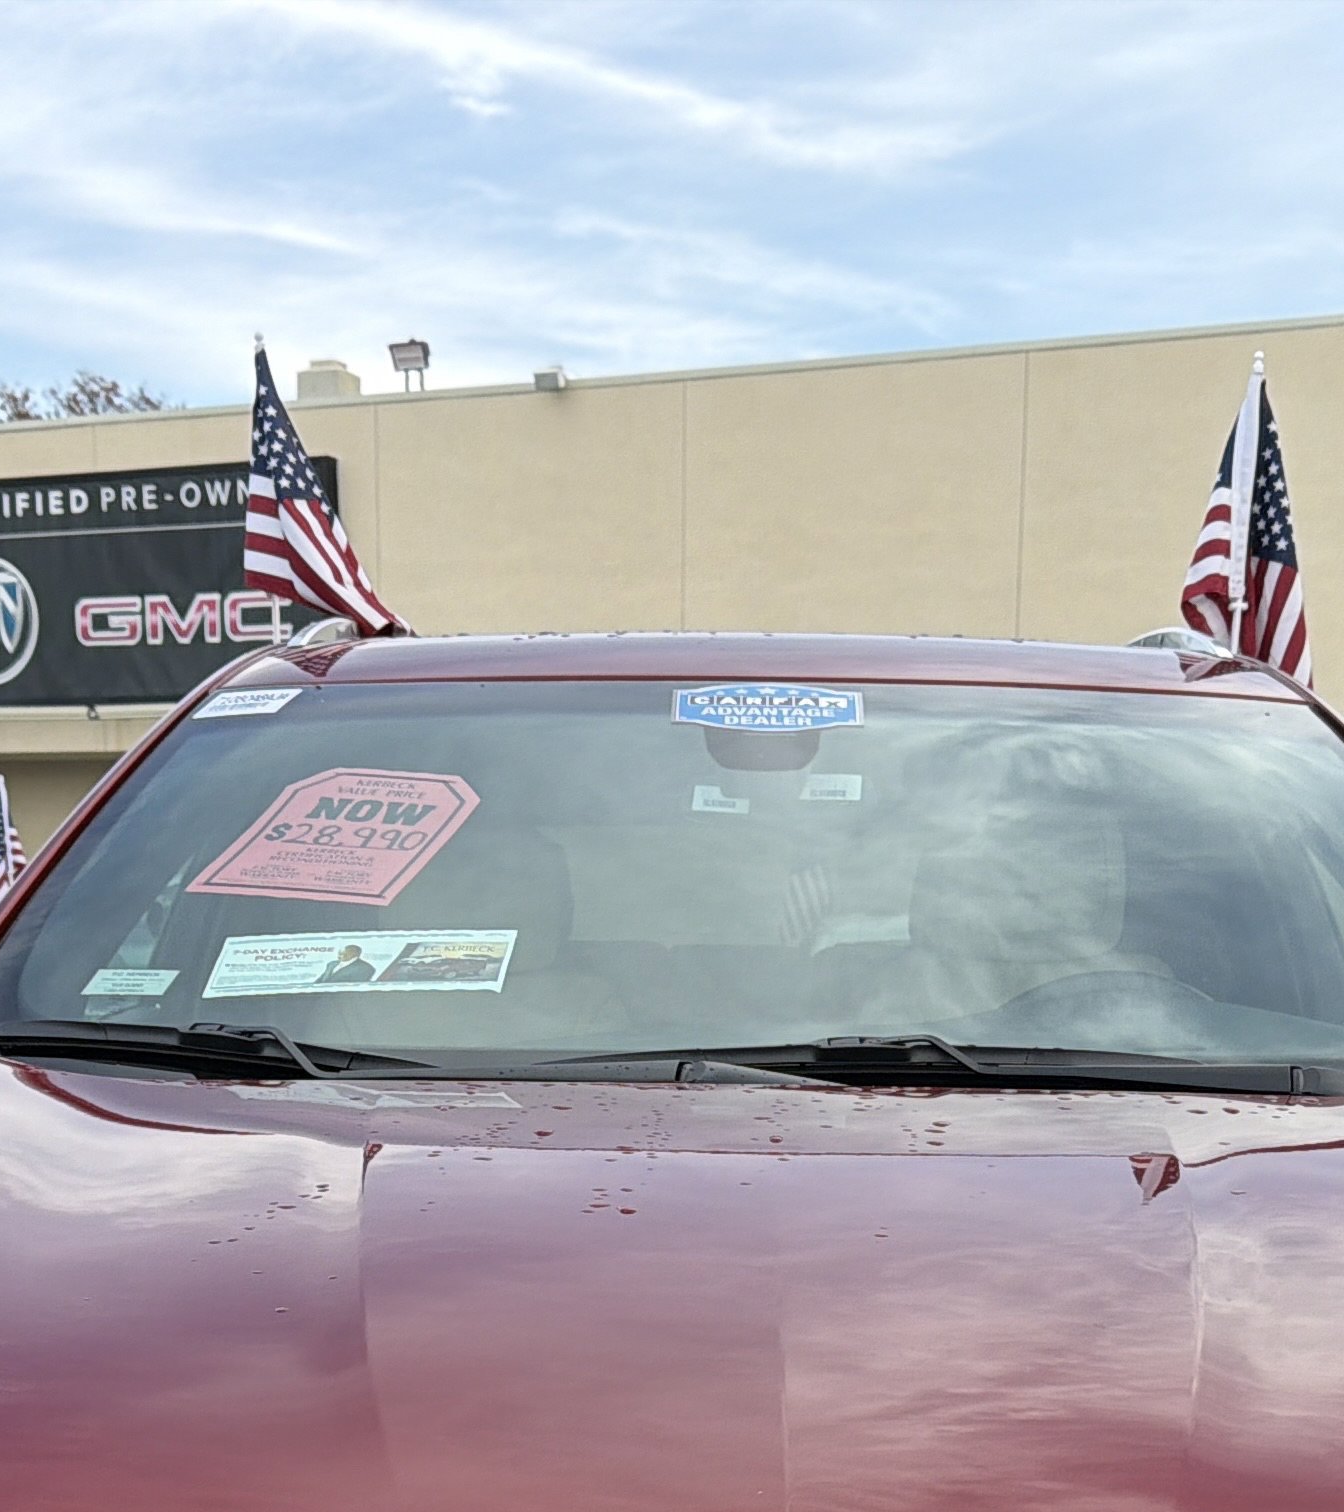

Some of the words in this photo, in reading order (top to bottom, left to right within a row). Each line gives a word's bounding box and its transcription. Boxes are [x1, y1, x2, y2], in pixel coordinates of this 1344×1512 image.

[100, 478, 250, 513] PRE-OWN
[75, 590, 293, 647] GMC
[689, 695, 847, 709] CARFAX
[701, 706, 836, 718] ADVANTAGE
[724, 716, 812, 726] DEALER
[356, 779, 417, 790] KERBECK
[385, 789, 426, 799] PRICE
[305, 797, 438, 827] NOW
[270, 946, 336, 955] EXCHANGE
